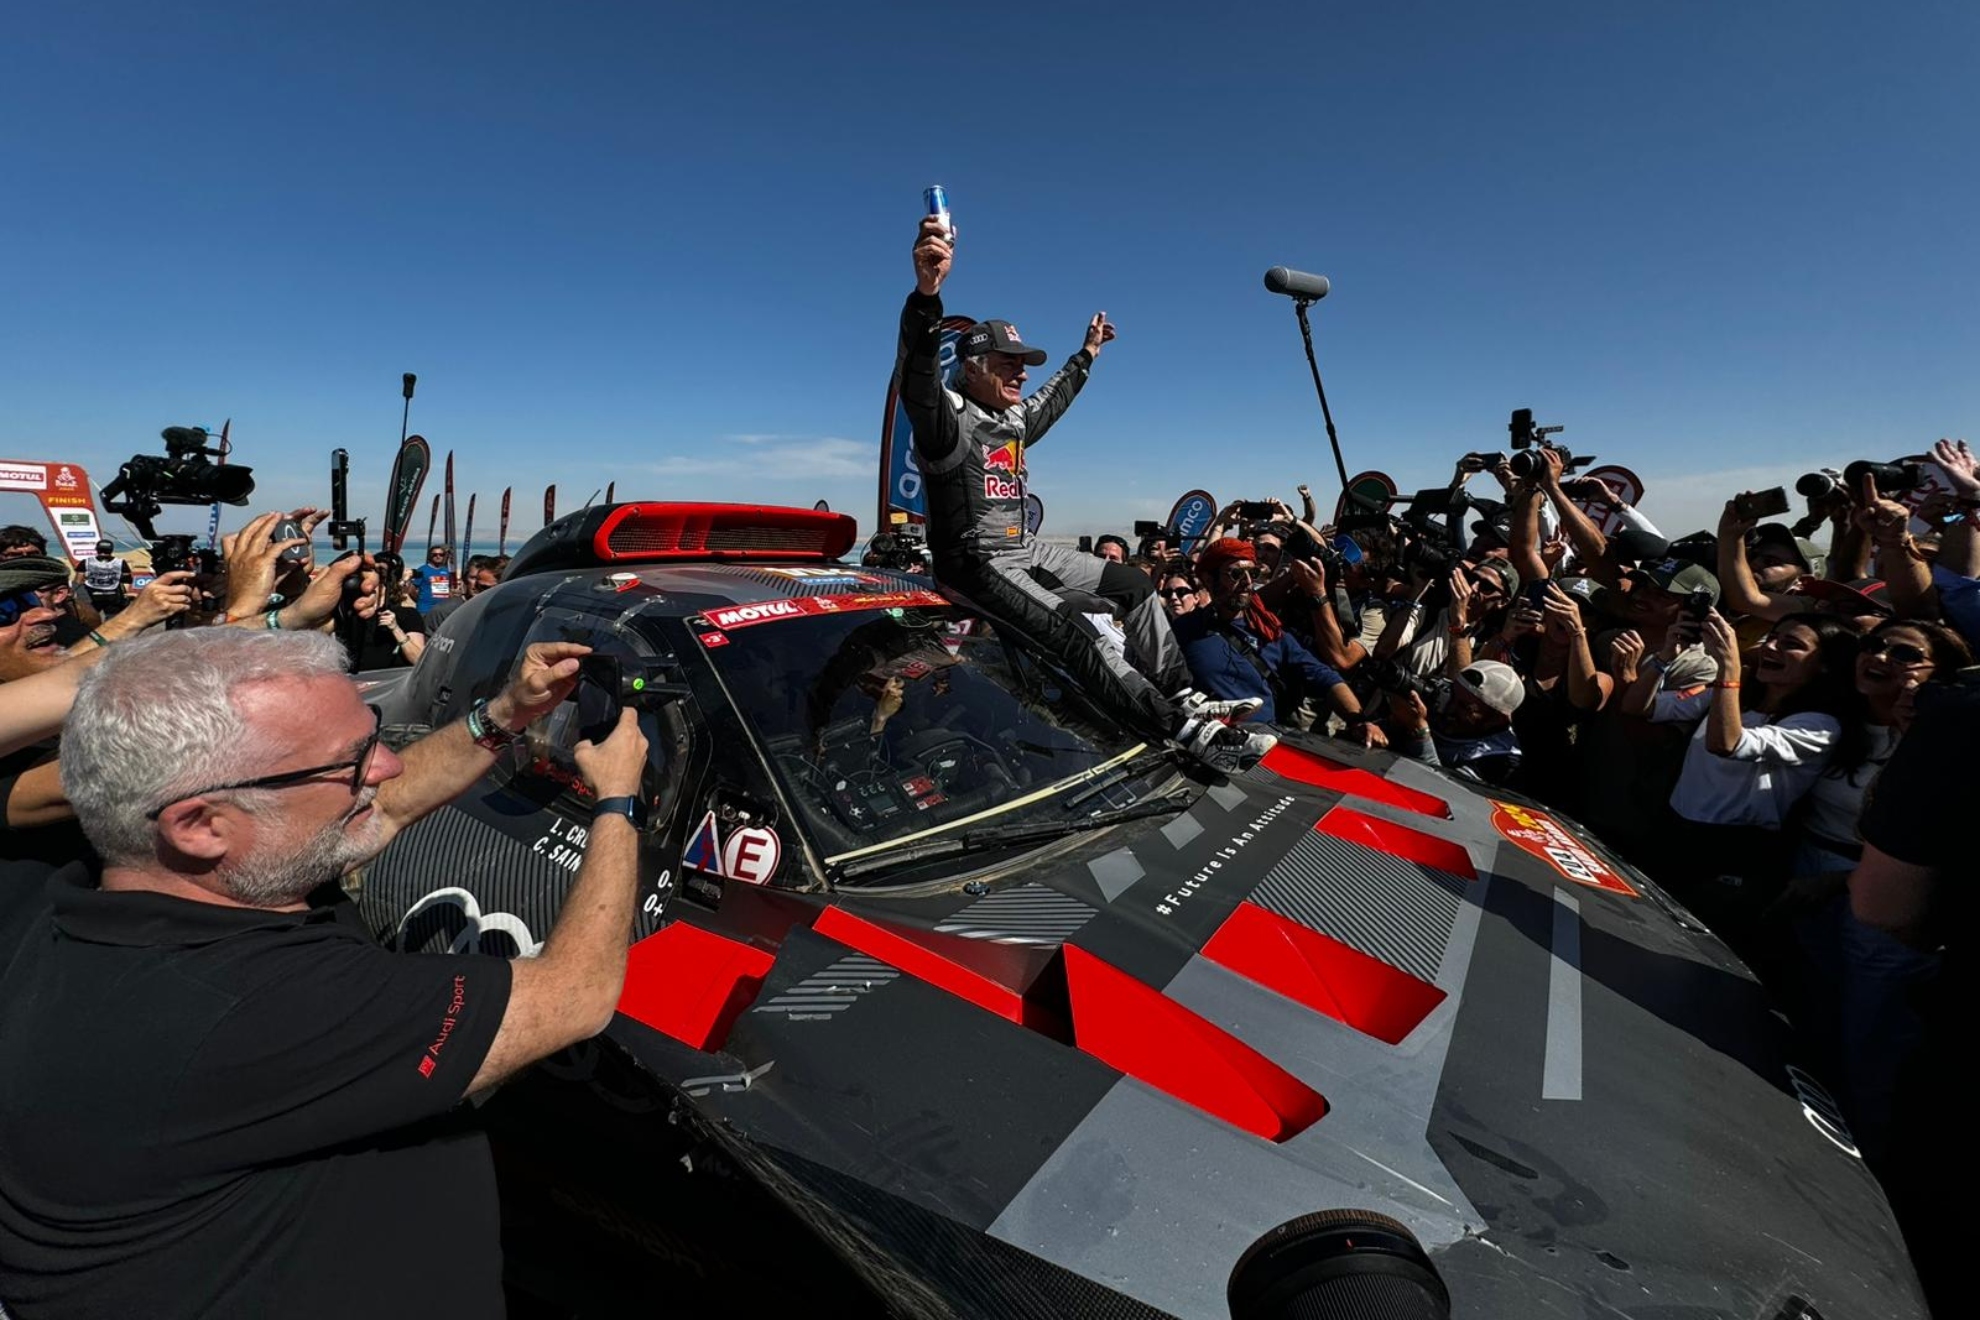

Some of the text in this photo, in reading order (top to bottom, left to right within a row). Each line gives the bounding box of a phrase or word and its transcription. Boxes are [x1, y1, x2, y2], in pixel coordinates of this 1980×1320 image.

[0, 471, 42, 481] MOTUL
[986, 475, 1018, 498] Red
[48, 496, 86, 505] FINISH
[718, 602, 799, 625] MOTUL
[550, 817, 563, 836] L.
[533, 836, 549, 855] C.
[1155, 795, 1296, 915] #Future Is An Attitude
[732, 834, 768, 882] E
[429, 975, 466, 1056] Audi Sport
